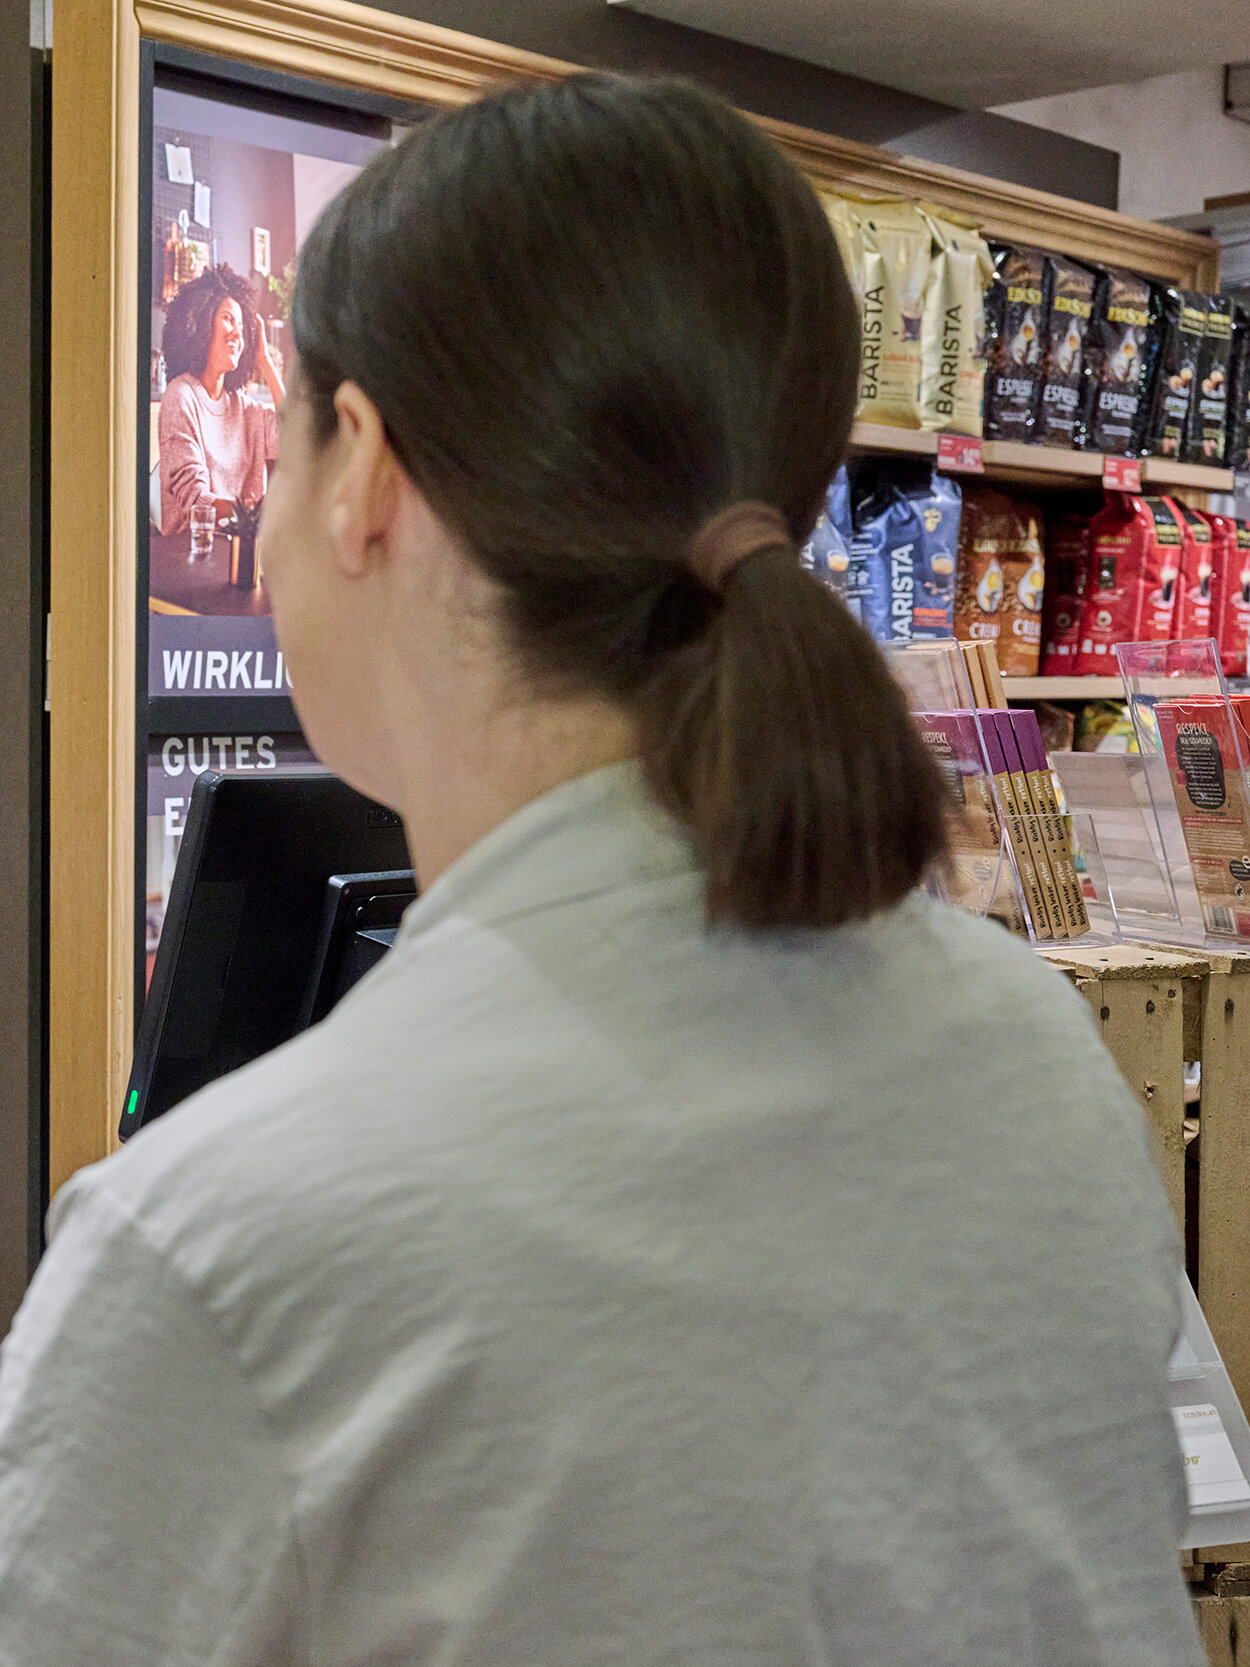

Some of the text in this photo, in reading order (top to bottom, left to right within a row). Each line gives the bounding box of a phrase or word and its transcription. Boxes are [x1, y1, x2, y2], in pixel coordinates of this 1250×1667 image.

[860, 286, 884, 399] BARISTA
[936, 305, 962, 415] BARISTA
[161, 735, 277, 777] GUTES
[164, 797, 193, 836] E
